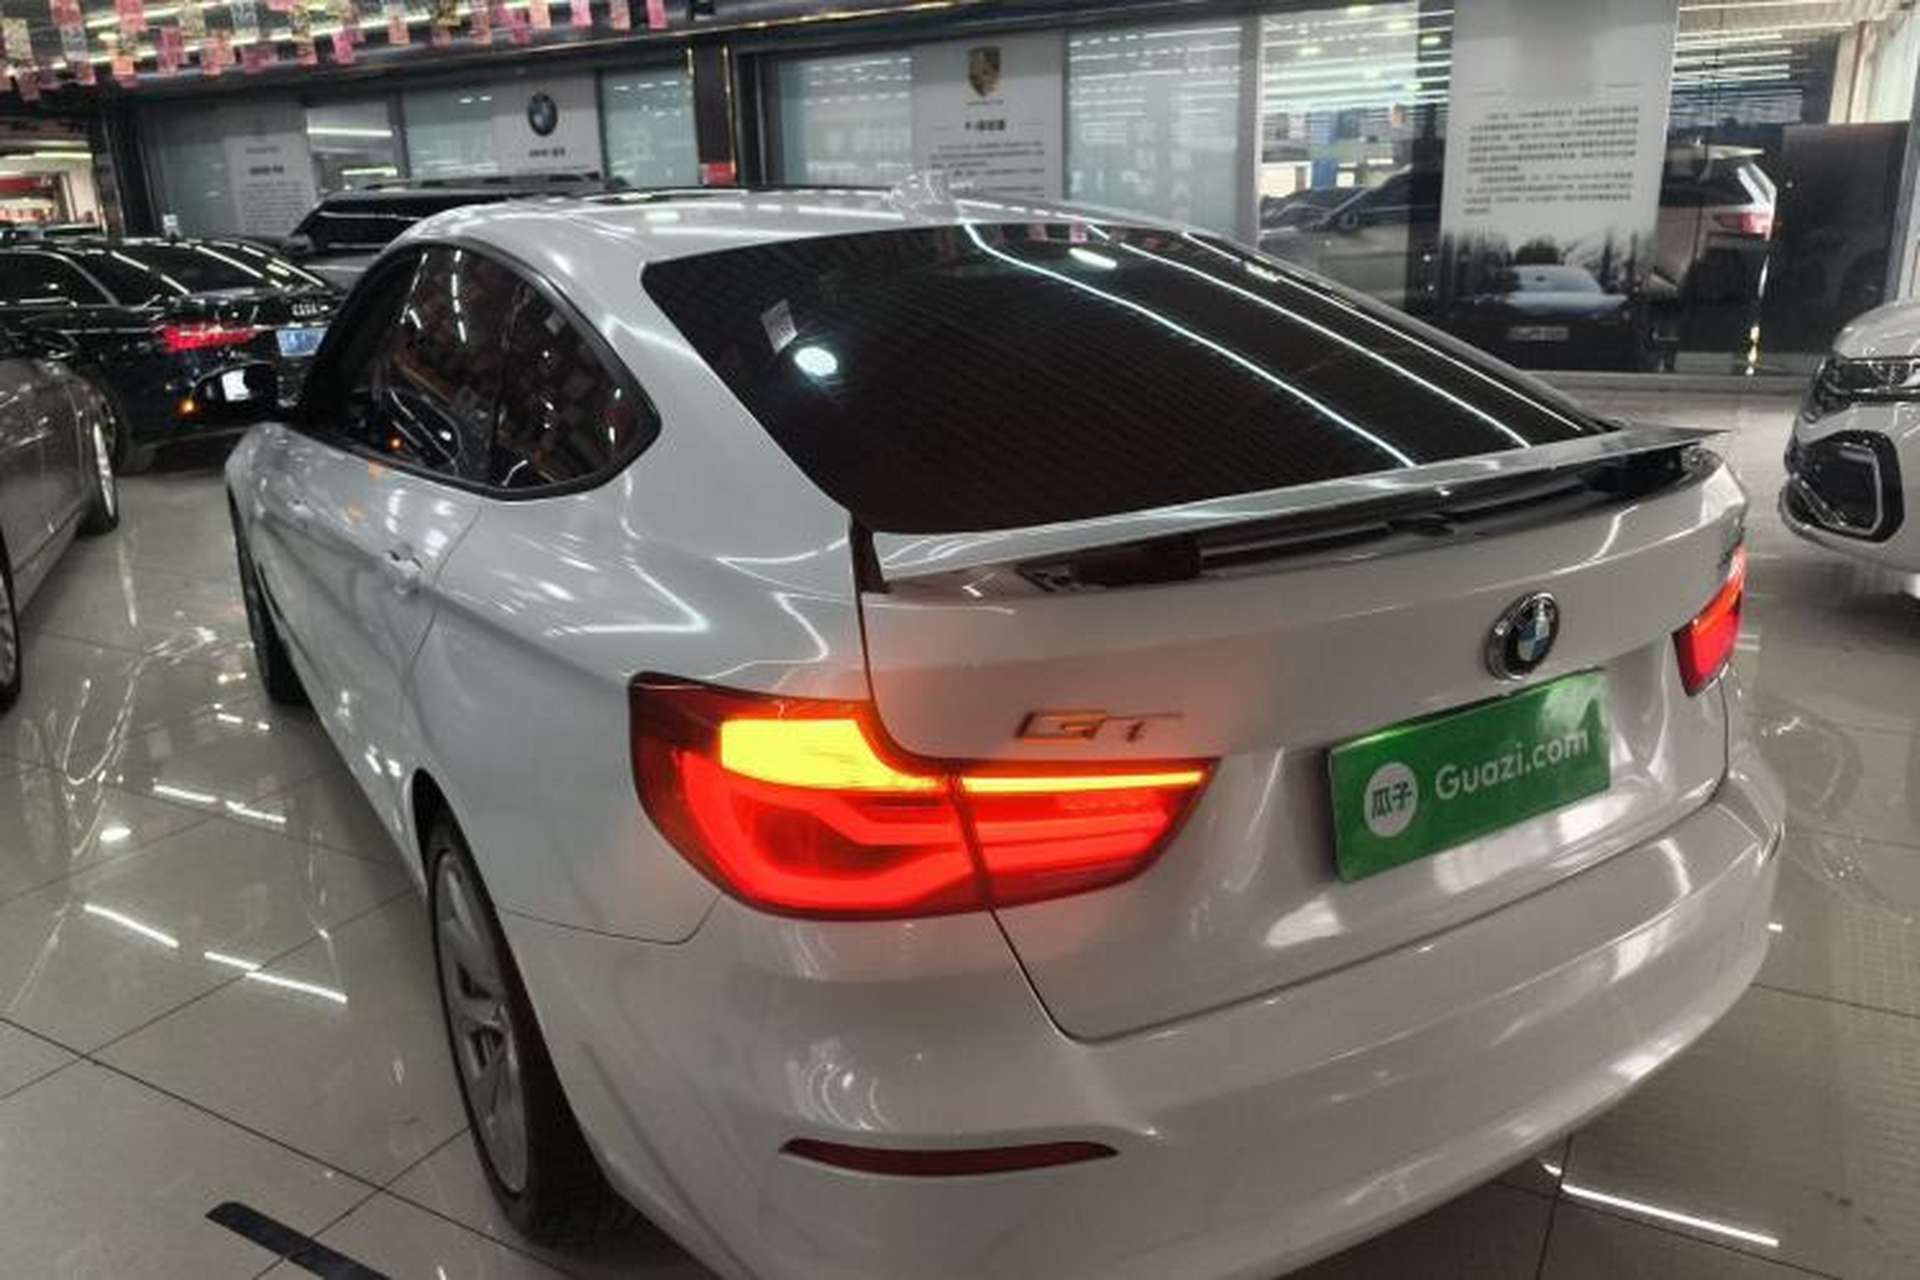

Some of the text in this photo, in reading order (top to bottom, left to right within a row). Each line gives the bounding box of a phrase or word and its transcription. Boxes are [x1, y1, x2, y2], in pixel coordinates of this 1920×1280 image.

[1014, 709, 1184, 743] GT
[1434, 730, 1589, 800] Guazi.com
[1370, 781, 1412, 820] 瓜子
